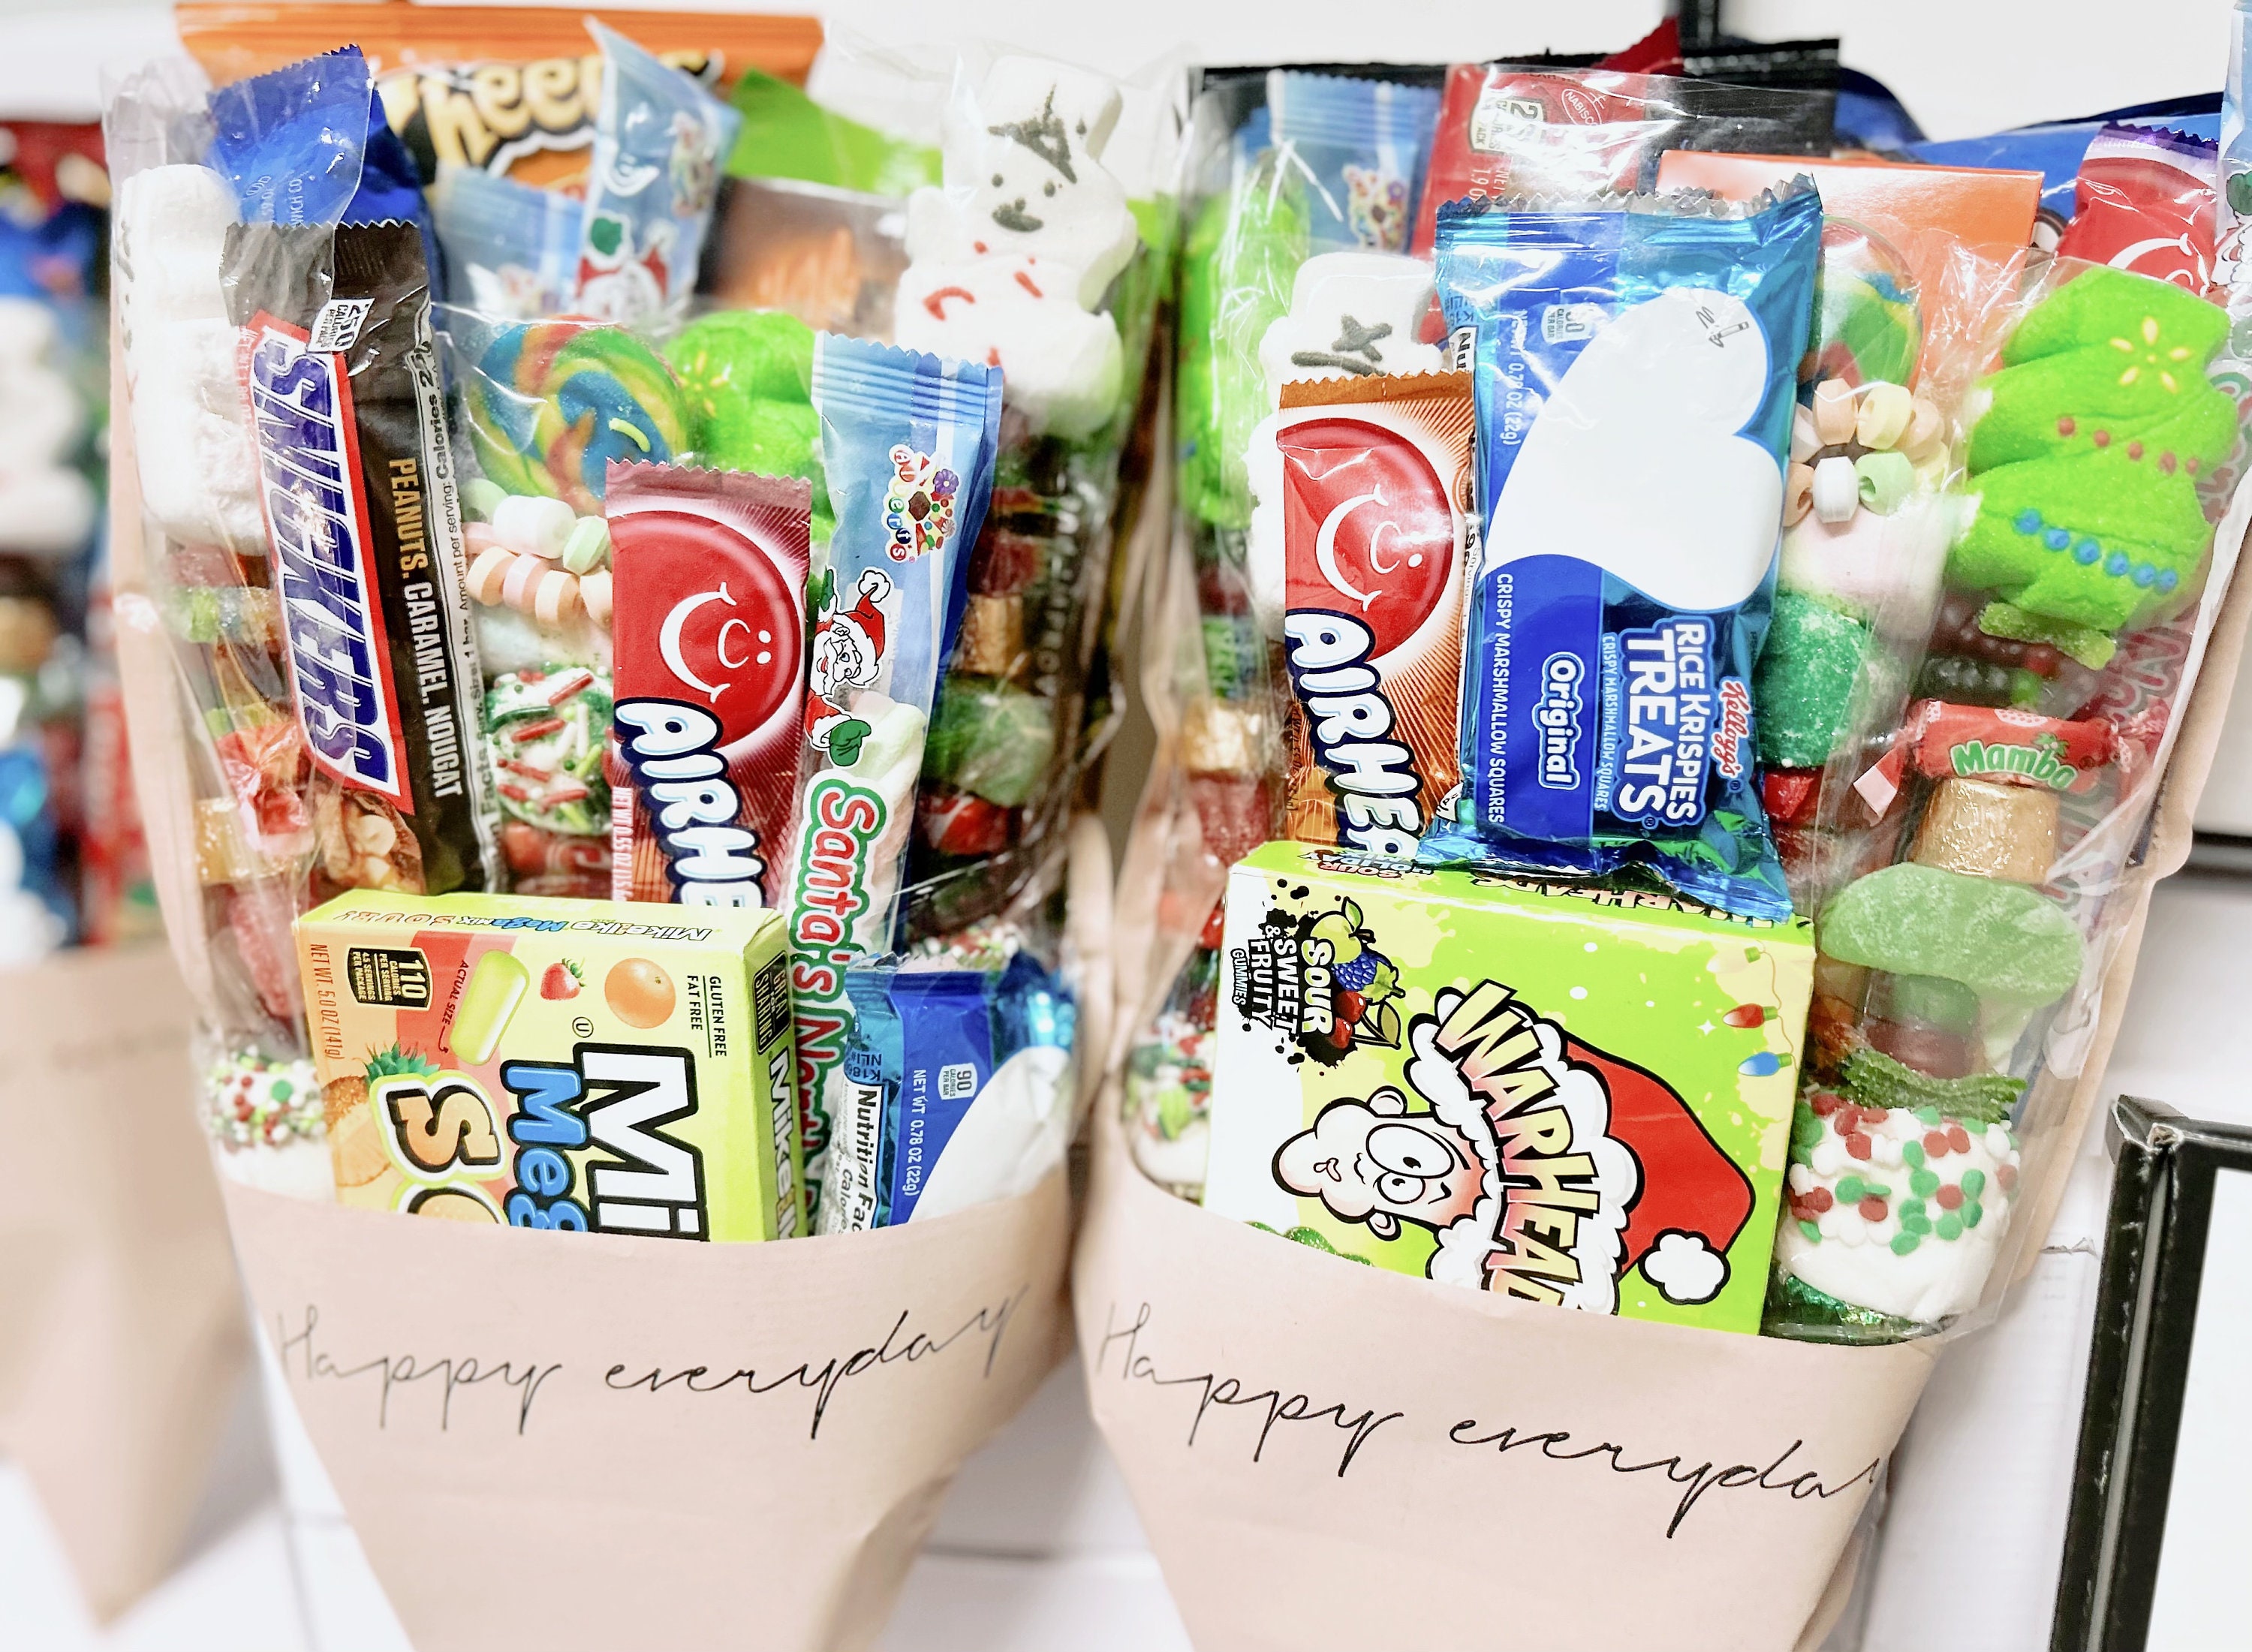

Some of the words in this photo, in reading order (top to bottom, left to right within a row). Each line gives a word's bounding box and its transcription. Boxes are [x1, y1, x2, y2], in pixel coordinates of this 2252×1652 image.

[1506, 392, 1522, 409] OZ
[429, 393, 450, 480] Calories
[1500, 411, 1522, 446] (22g)
[387, 457, 429, 579] PEANUTS.
[443, 481, 459, 533] serving:
[252, 338, 390, 783] SNICKERS
[450, 535, 464, 559] per
[453, 560, 469, 611] Amount
[1495, 573, 1514, 630] CRISPY
[403, 581, 448, 704] CARAMEL.
[1602, 636, 1616, 683] CRISPY
[1675, 623, 1705, 684] RICE
[1489, 632, 1512, 754] MARSHMALLOW
[1538, 659, 1579, 784] Original
[1598, 684, 1615, 760] MARSHMALLOW
[1618, 628, 1675, 814] TREATS
[1711, 679, 1753, 781] Kellogg's
[423, 704, 463, 799] NOUGAT
[1666, 689, 1712, 820] KRISPIES
[1951, 739, 2078, 791] Mambo
[612, 786, 634, 808] NET
[1487, 756, 1507, 824] SQUARES
[1594, 761, 1612, 811] SQUARES
[612, 808, 634, 826] WT
[612, 826, 634, 851] 0.55
[612, 852, 634, 868] OZ
[1317, 861, 1402, 880] SOUR
[793, 787, 881, 998] Santa's
[491, 915, 569, 933] Mega
[1264, 924, 1281, 939] &
[309, 943, 330, 966] NET
[351, 950, 363, 967] PER
[361, 951, 372, 963] 4.5
[378, 952, 389, 969] PER
[315, 967, 334, 987] WT.
[354, 967, 367, 1001] PACKAGE
[363, 964, 376, 1001] SERVINGS
[381, 968, 393, 1002] SERVING
[389, 959, 402, 996] CALORIES
[398, 958, 428, 999] 110
[448, 959, 470, 1001] ACTUAL
[687, 974, 700, 998] FAT
[773, 970, 790, 1019] GREAT
[1232, 949, 1248, 1006] GUMMIES
[1250, 940, 1274, 1027] FRUITY
[1273, 938, 1299, 1034] SWEET
[1300, 937, 1335, 1036] SOUR
[317, 989, 338, 1006] 5.0
[441, 1001, 456, 1026] SIZE
[689, 1001, 703, 1031] FREE
[709, 976, 724, 1024] GLUTEN
[754, 973, 775, 1045] SHARING
[320, 1009, 340, 1025] OZ
[321, 1025, 345, 1061] (141g)
[713, 1028, 727, 1057] FREE
[912, 1069, 927, 1093] NET
[949, 1068, 957, 1097] CALORIES
[956, 1070, 973, 1091] 90
[911, 1095, 927, 1114] WT
[857, 1089, 878, 1189] Nutrition
[909, 1119, 926, 1145] 0.78
[907, 1147, 923, 1163] OZ
[902, 1165, 921, 1197] (22g)
[276, 1302, 563, 1434] Happy
[604, 1284, 1029, 1440] everyday
[1095, 1301, 1404, 1478] Happy
